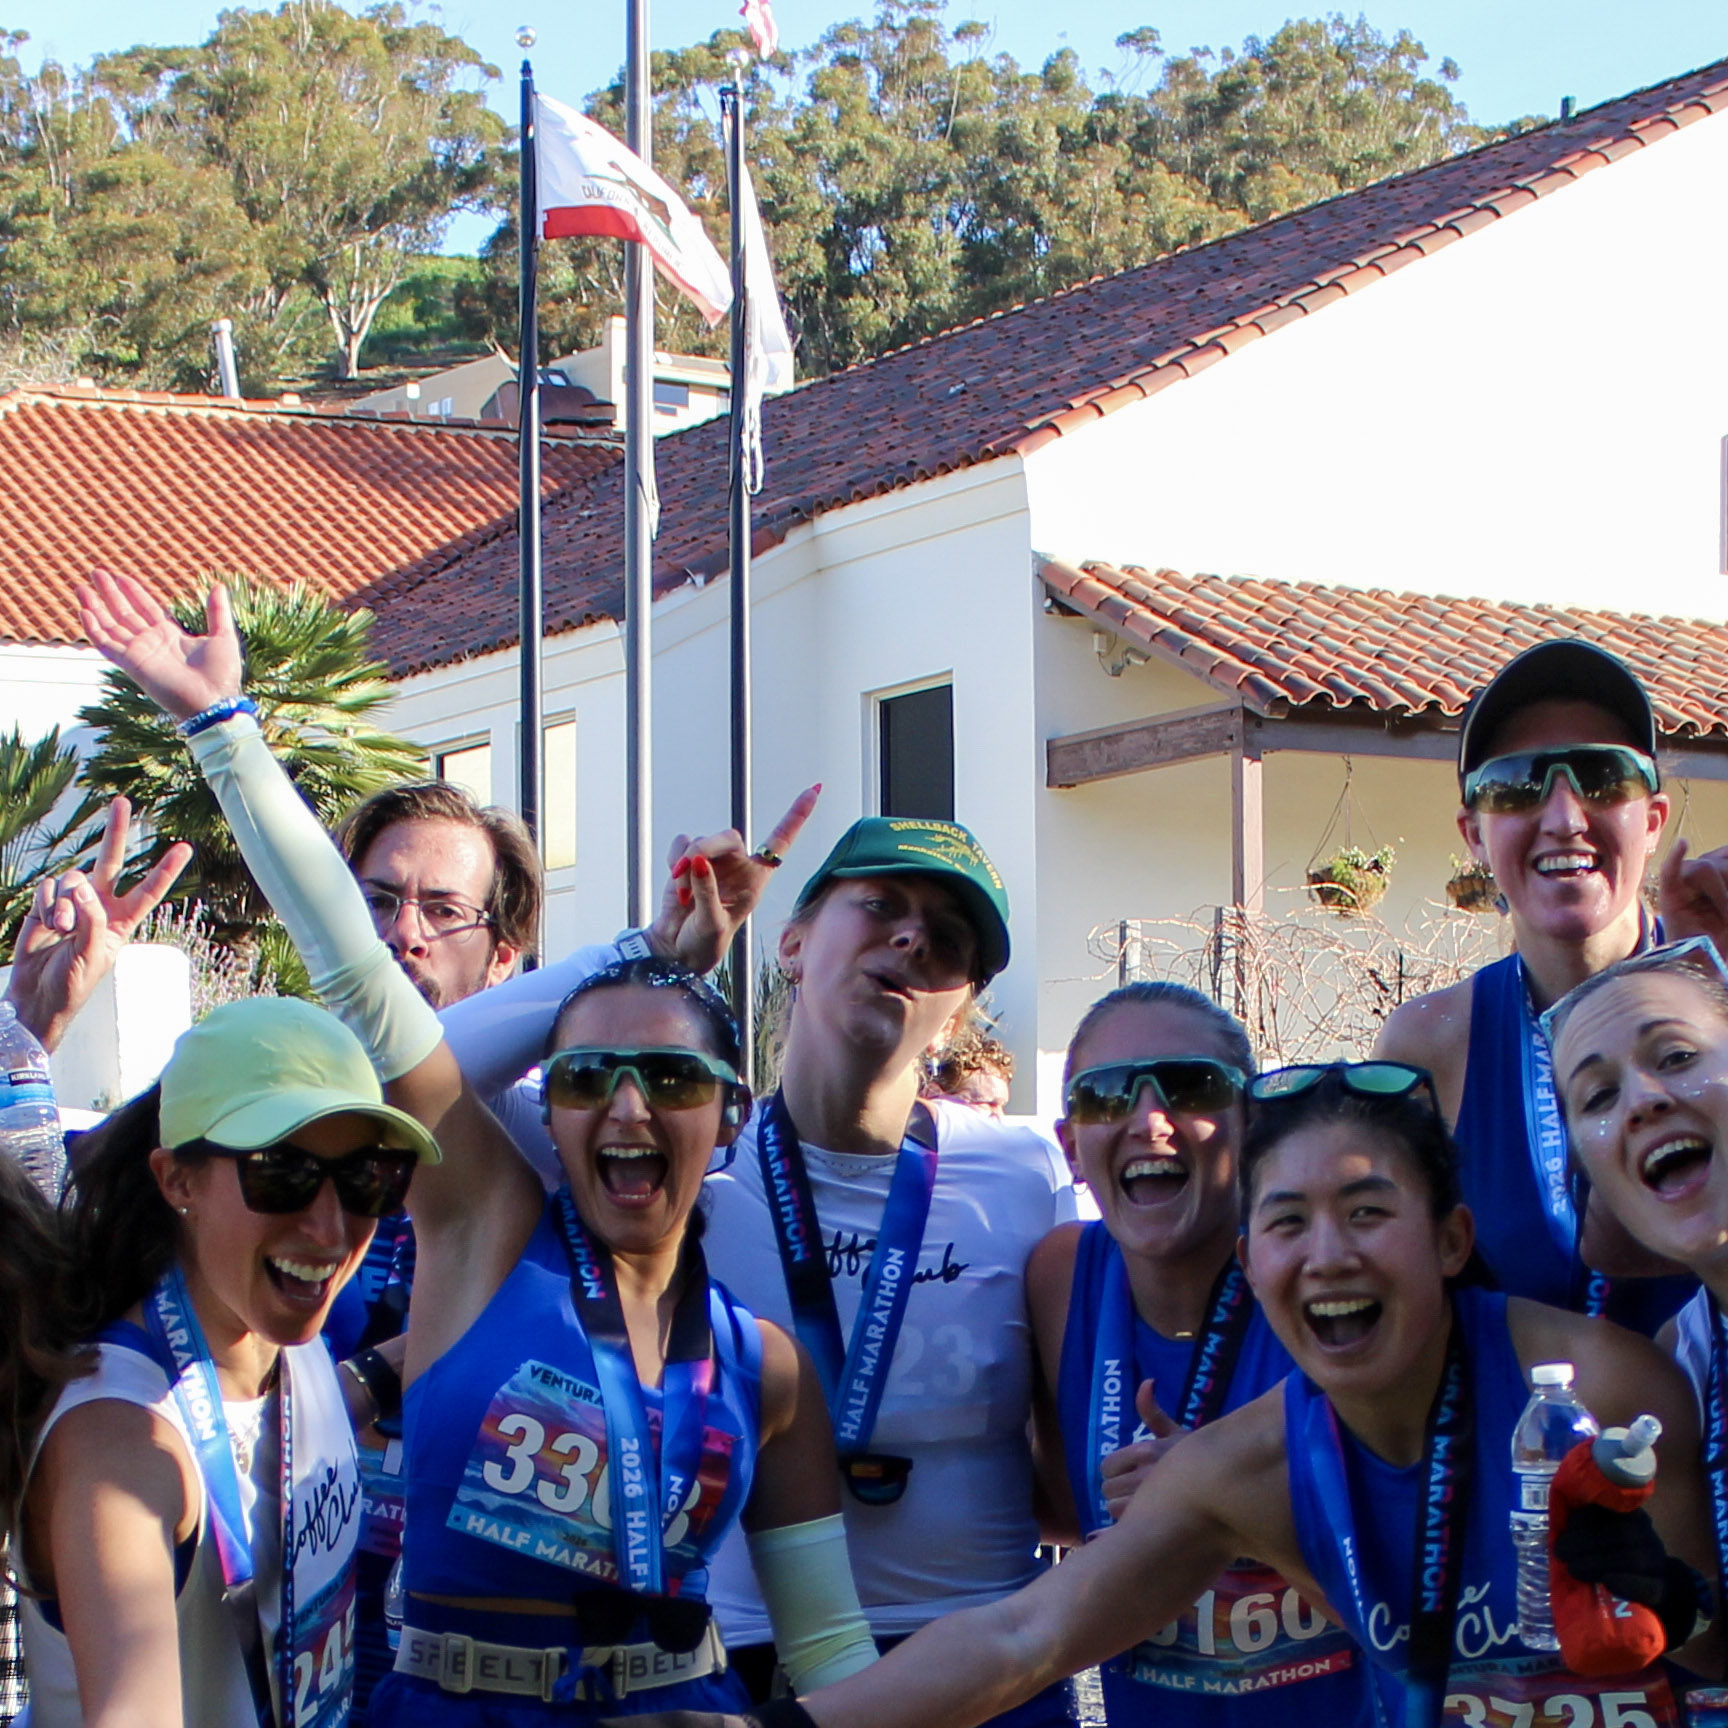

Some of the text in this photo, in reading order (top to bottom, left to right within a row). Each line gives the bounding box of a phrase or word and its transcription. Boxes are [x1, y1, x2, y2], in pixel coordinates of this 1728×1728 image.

[889, 821, 1003, 889] SHELLBACK TAVERN
[1537, 1087, 1562, 1149] HALF
[763, 1121, 811, 1264] MARATHON
[1545, 1156, 1569, 1217] 2026
[839, 1246, 906, 1442] HALF MARATHON
[1182, 1331, 1225, 1432] MARAT
[1101, 1359, 1121, 1456] RATHON
[483, 1413, 701, 1549] 33
[619, 1437, 649, 1575] 2026 HALF
[1422, 1433, 1456, 1614] MARATHON
[466, 1515, 619, 1582] HALF MARAT
[1142, 1658, 1332, 1696] HALF MARATHON
[1456, 1605, 1521, 1659] Clu
